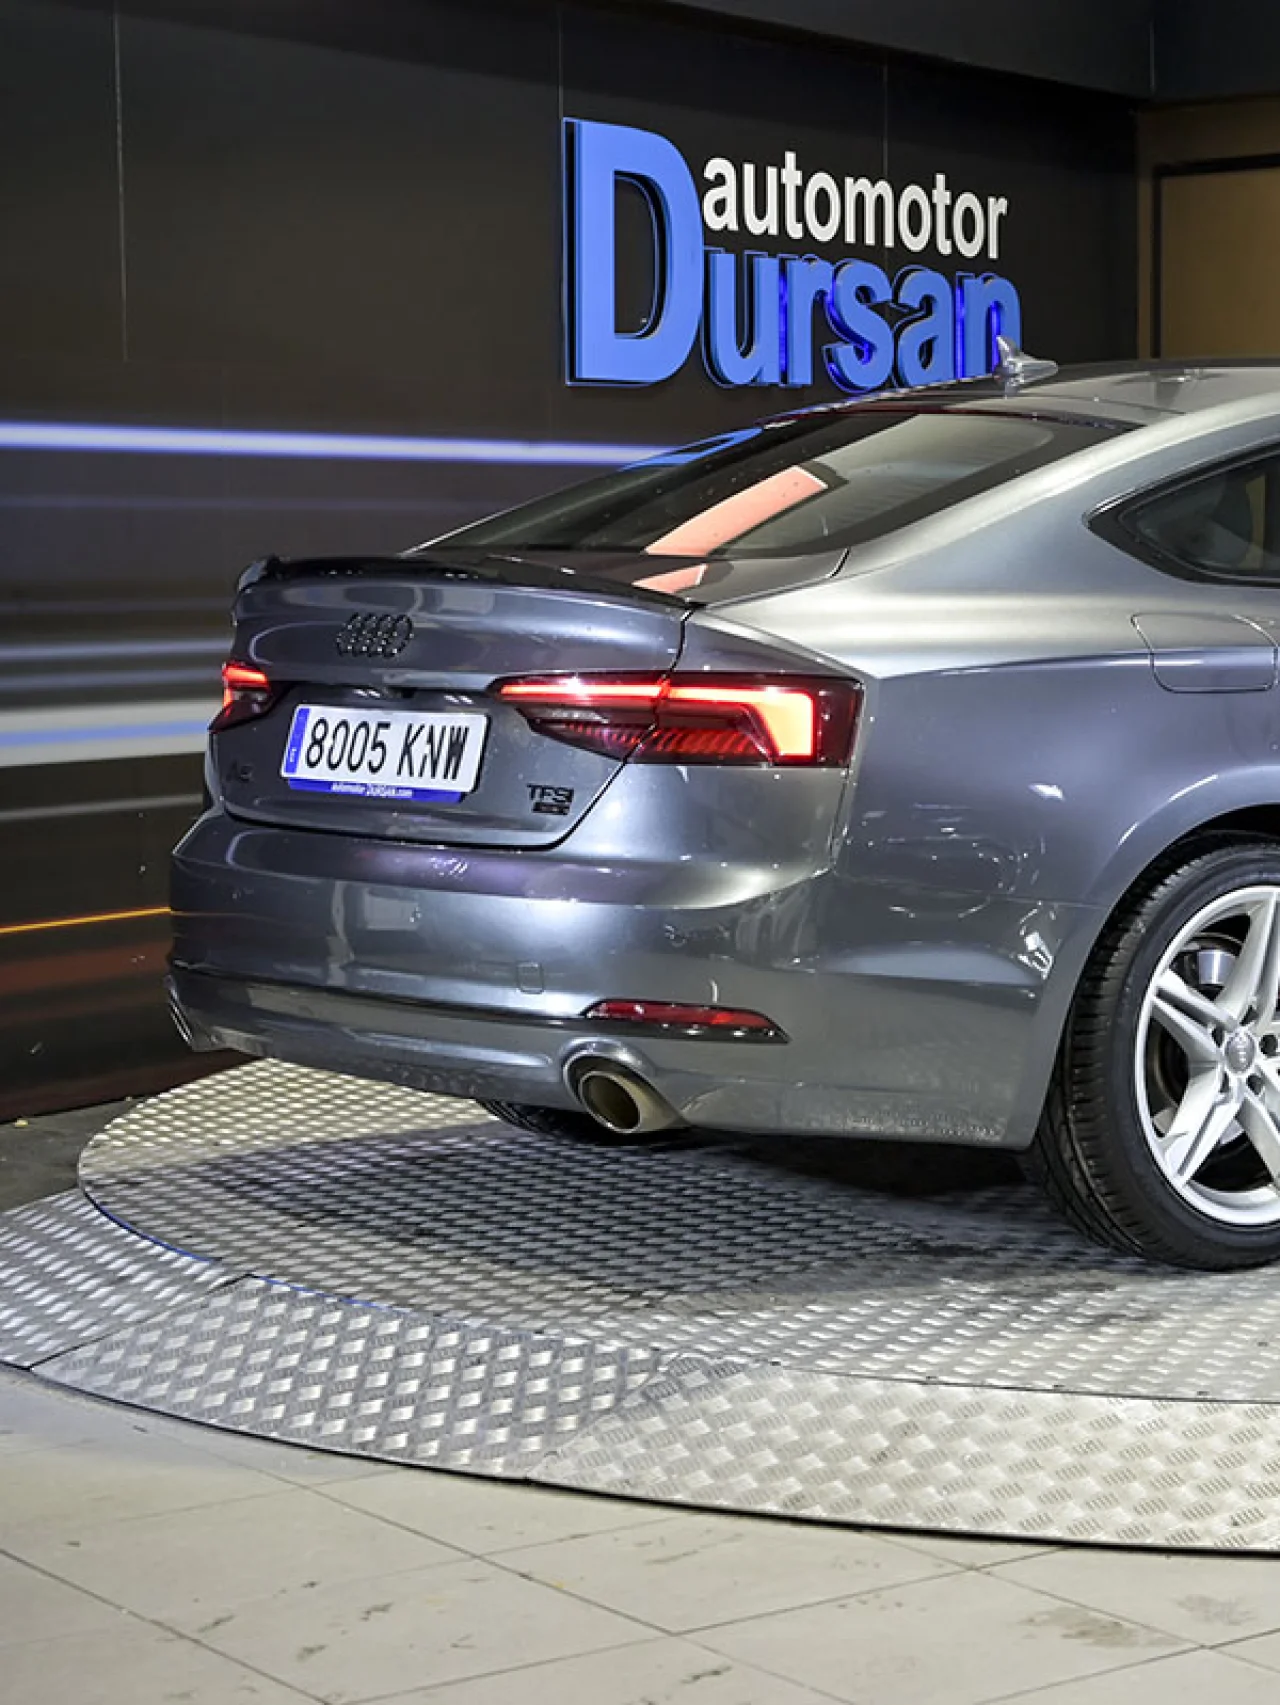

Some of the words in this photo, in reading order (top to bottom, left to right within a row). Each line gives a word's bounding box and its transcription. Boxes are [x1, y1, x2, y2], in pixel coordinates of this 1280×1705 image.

[703, 152, 1007, 258] automotor
[562, 117, 1021, 391] Dursan
[306, 718, 390, 773] 8005
[396, 723, 469, 780] KNW
[527, 784, 574, 803] TFSI
